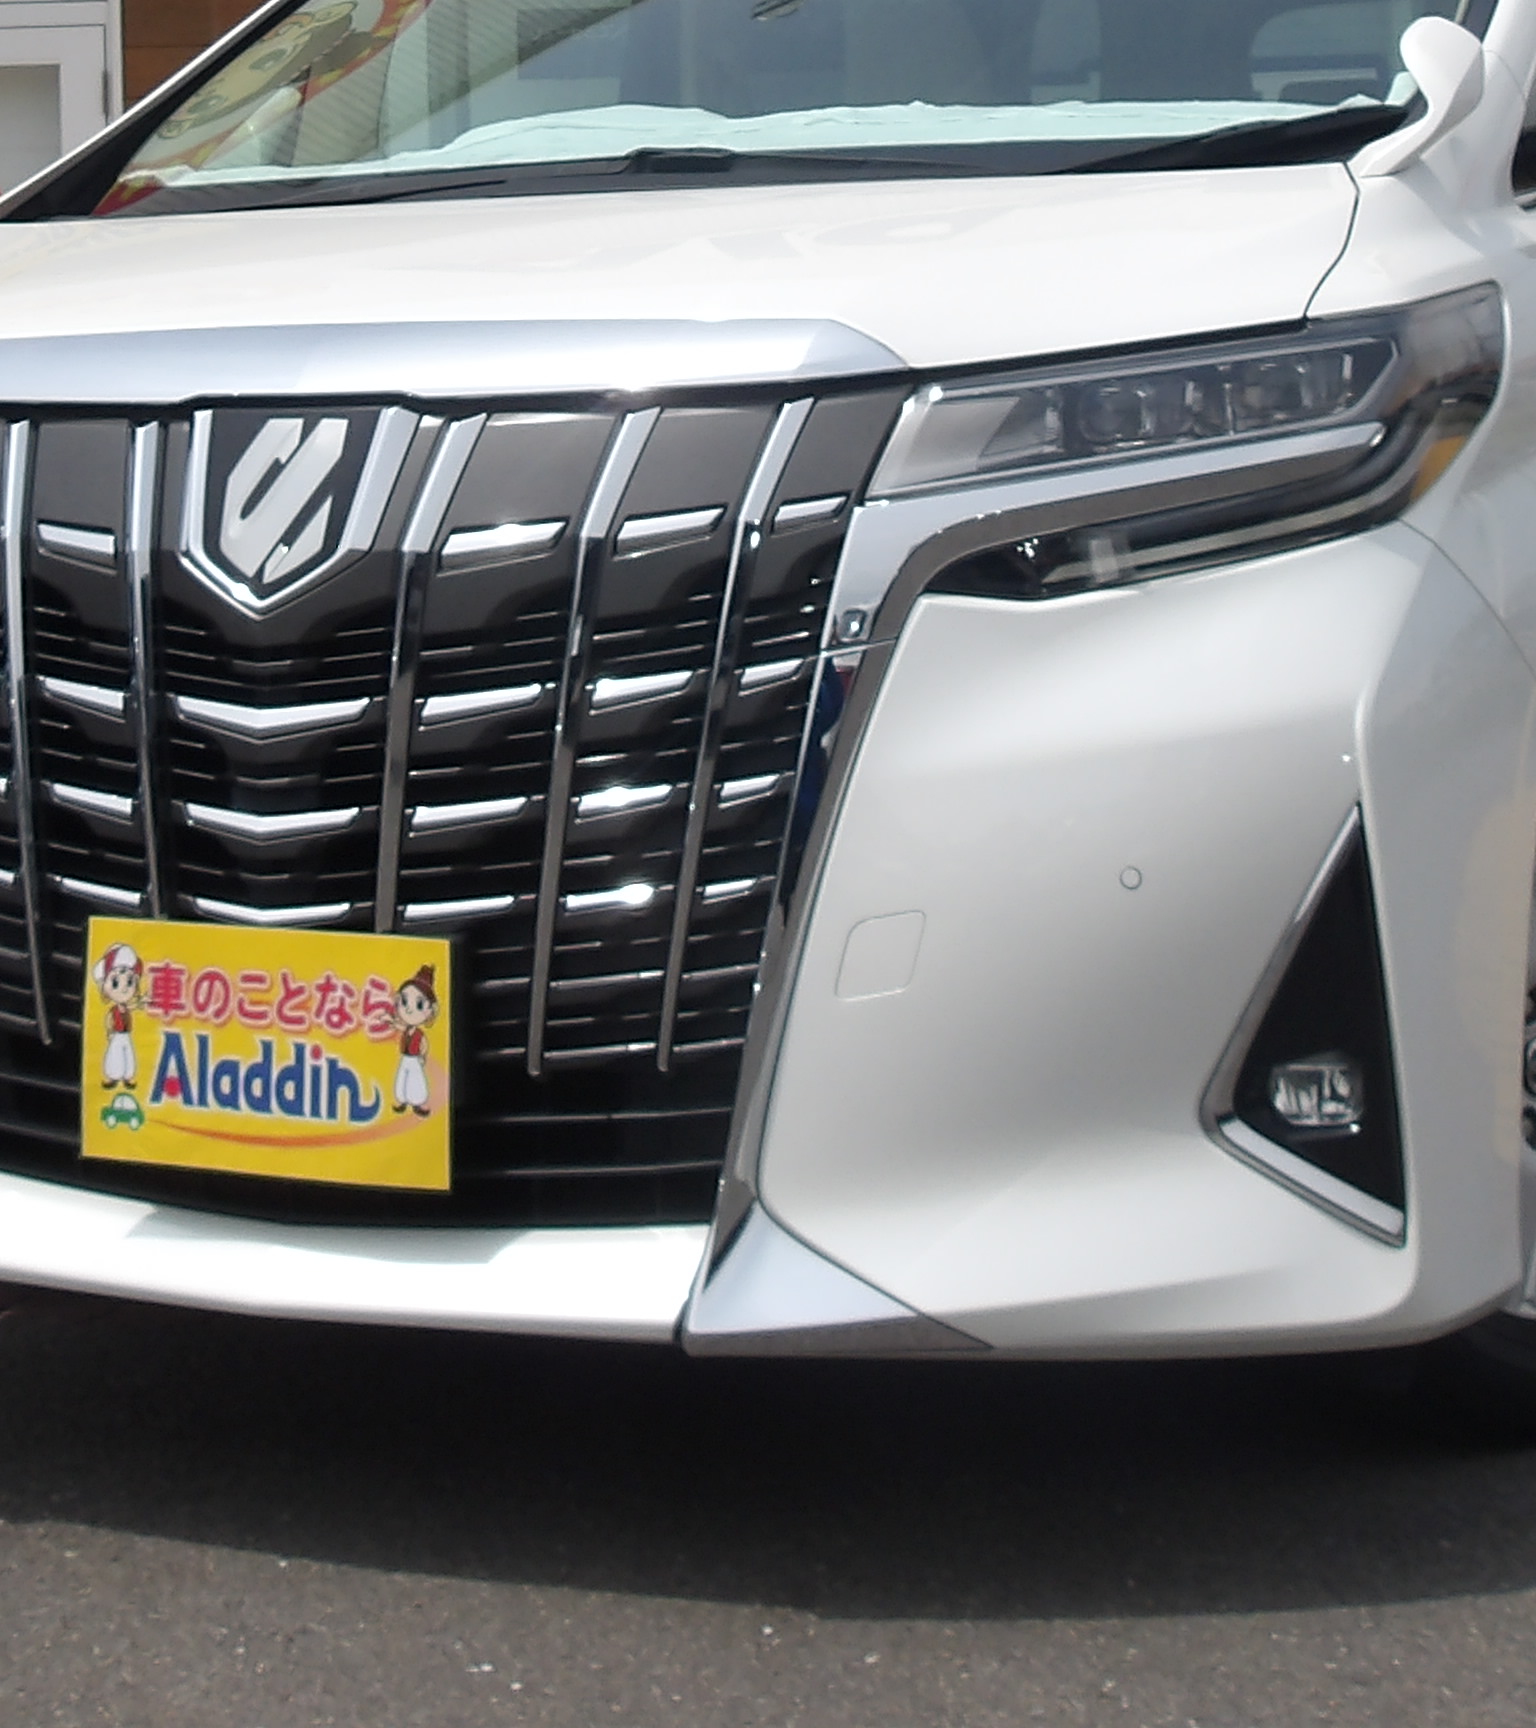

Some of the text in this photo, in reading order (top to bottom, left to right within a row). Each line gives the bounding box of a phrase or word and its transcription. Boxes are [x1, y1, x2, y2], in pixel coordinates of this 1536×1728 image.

[146, 961, 397, 1036] 車のことなら
[148, 1030, 383, 1125] Aladdin
